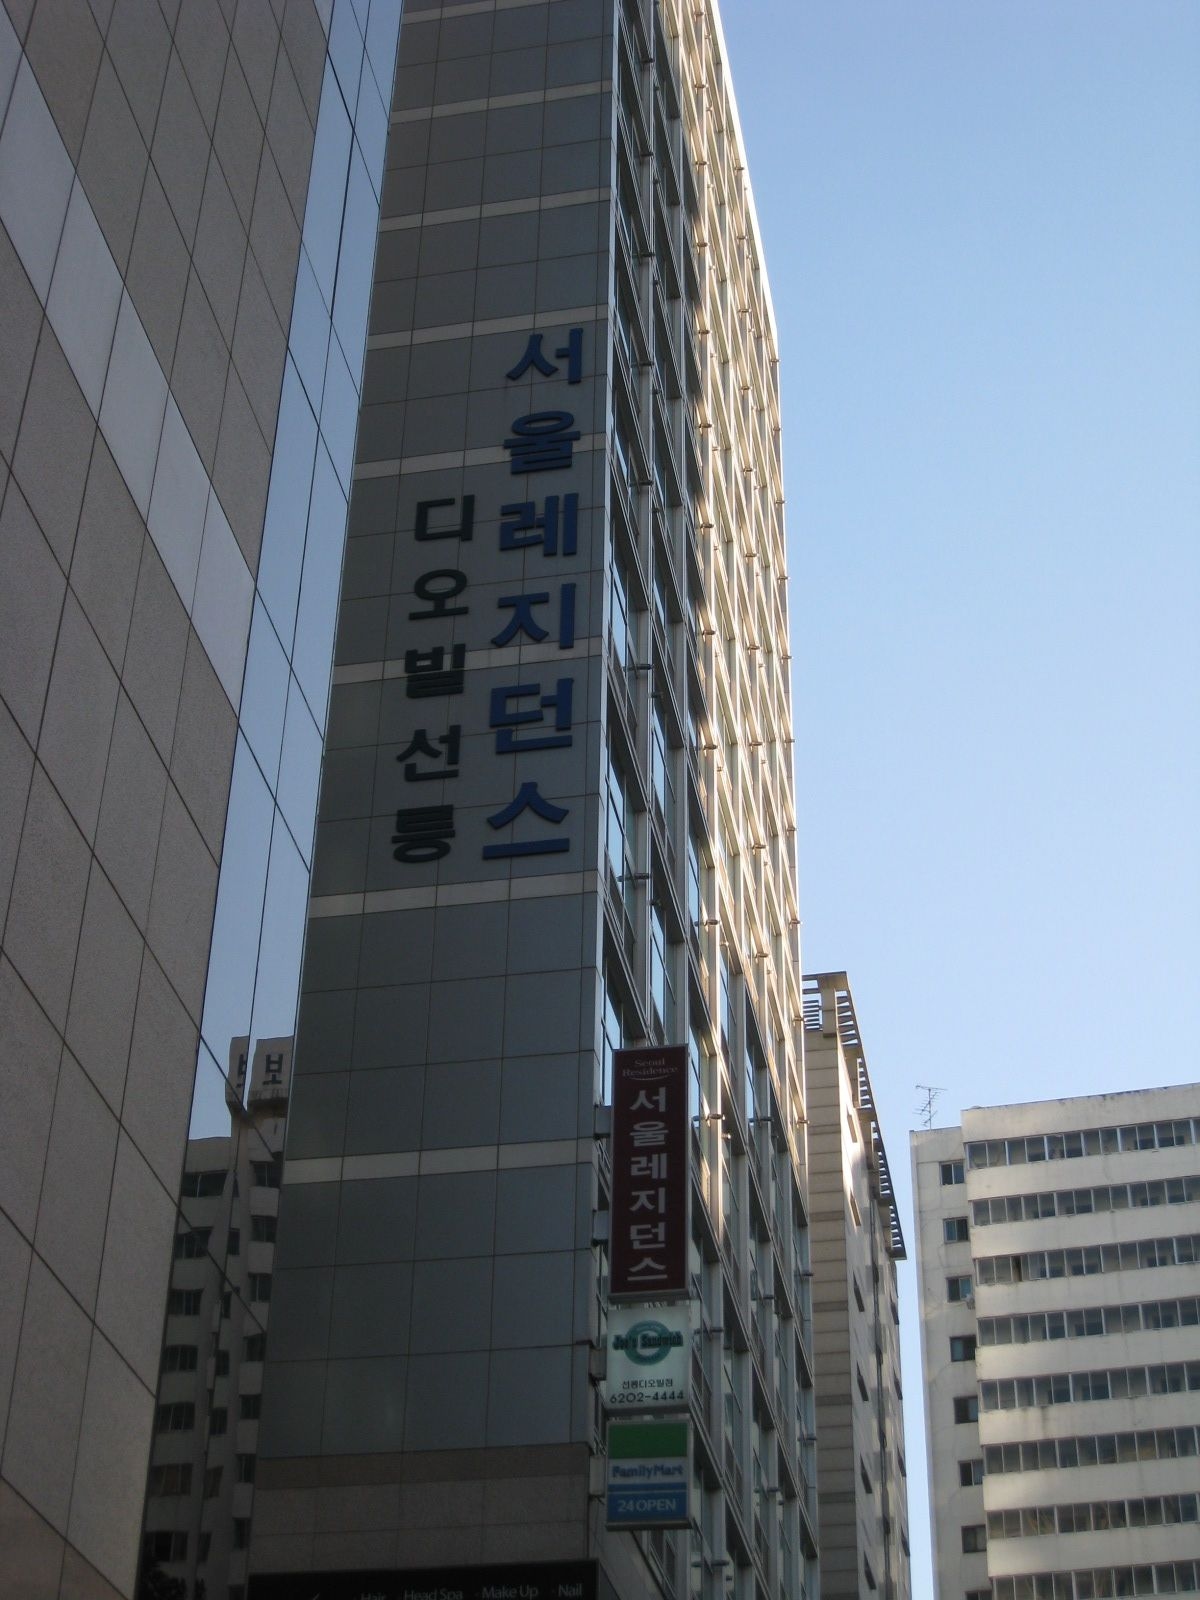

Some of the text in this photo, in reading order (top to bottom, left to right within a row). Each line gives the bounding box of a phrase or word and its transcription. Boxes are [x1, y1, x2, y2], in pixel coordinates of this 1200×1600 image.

[483, 327, 583, 860] 서울레지던스
[391, 494, 476, 864] 디오빌선릉
[634, 1057, 665, 1067] Seoul
[622, 1066, 678, 1077] Residence
[627, 1086, 669, 1282] 서울레지던스
[609, 1391, 684, 1404] 6202-4444
[482, 1585, 516, 1599] Make
[518, 1585, 539, 1600] Up
[558, 1583, 583, 1597] Nail
